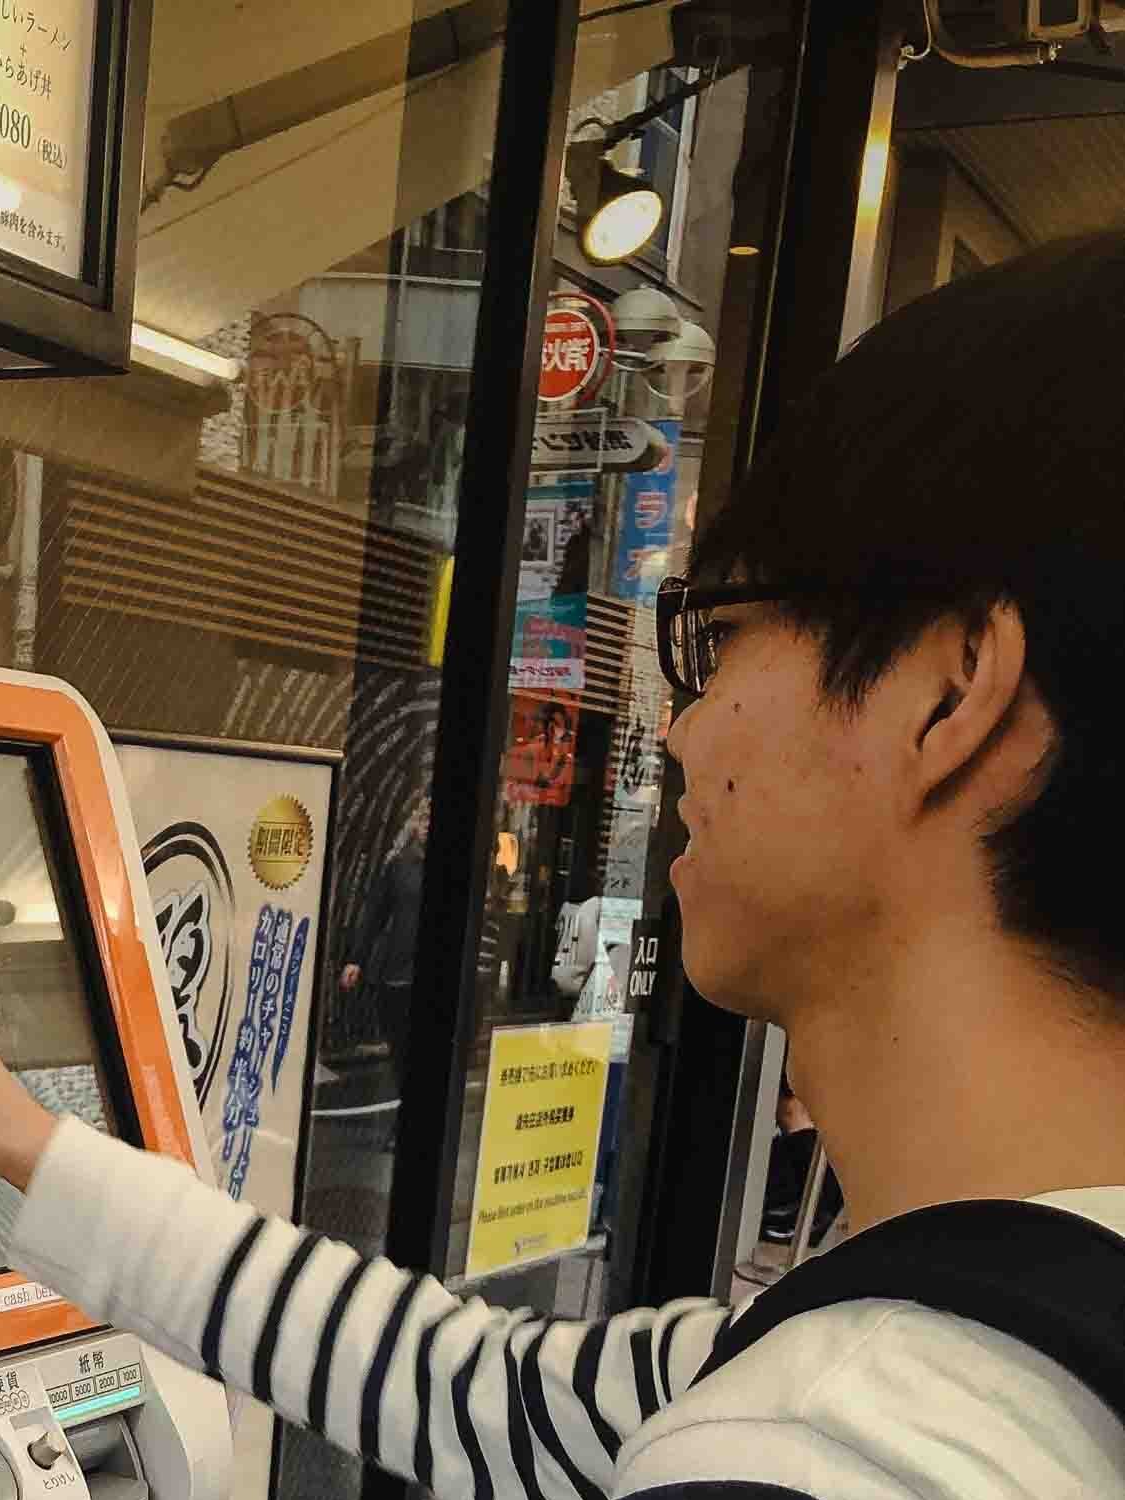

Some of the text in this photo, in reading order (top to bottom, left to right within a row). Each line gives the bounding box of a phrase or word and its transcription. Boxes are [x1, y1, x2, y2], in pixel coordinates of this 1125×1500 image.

[4, 1287, 30, 1306] cash
[78, 1351, 105, 1374] 紙幣
[75, 1383, 92, 1397] 5000
[98, 1375, 115, 1389] 2000
[122, 1367, 138, 1381] 1000
[43, 1472, 77, 1490] とりけし
